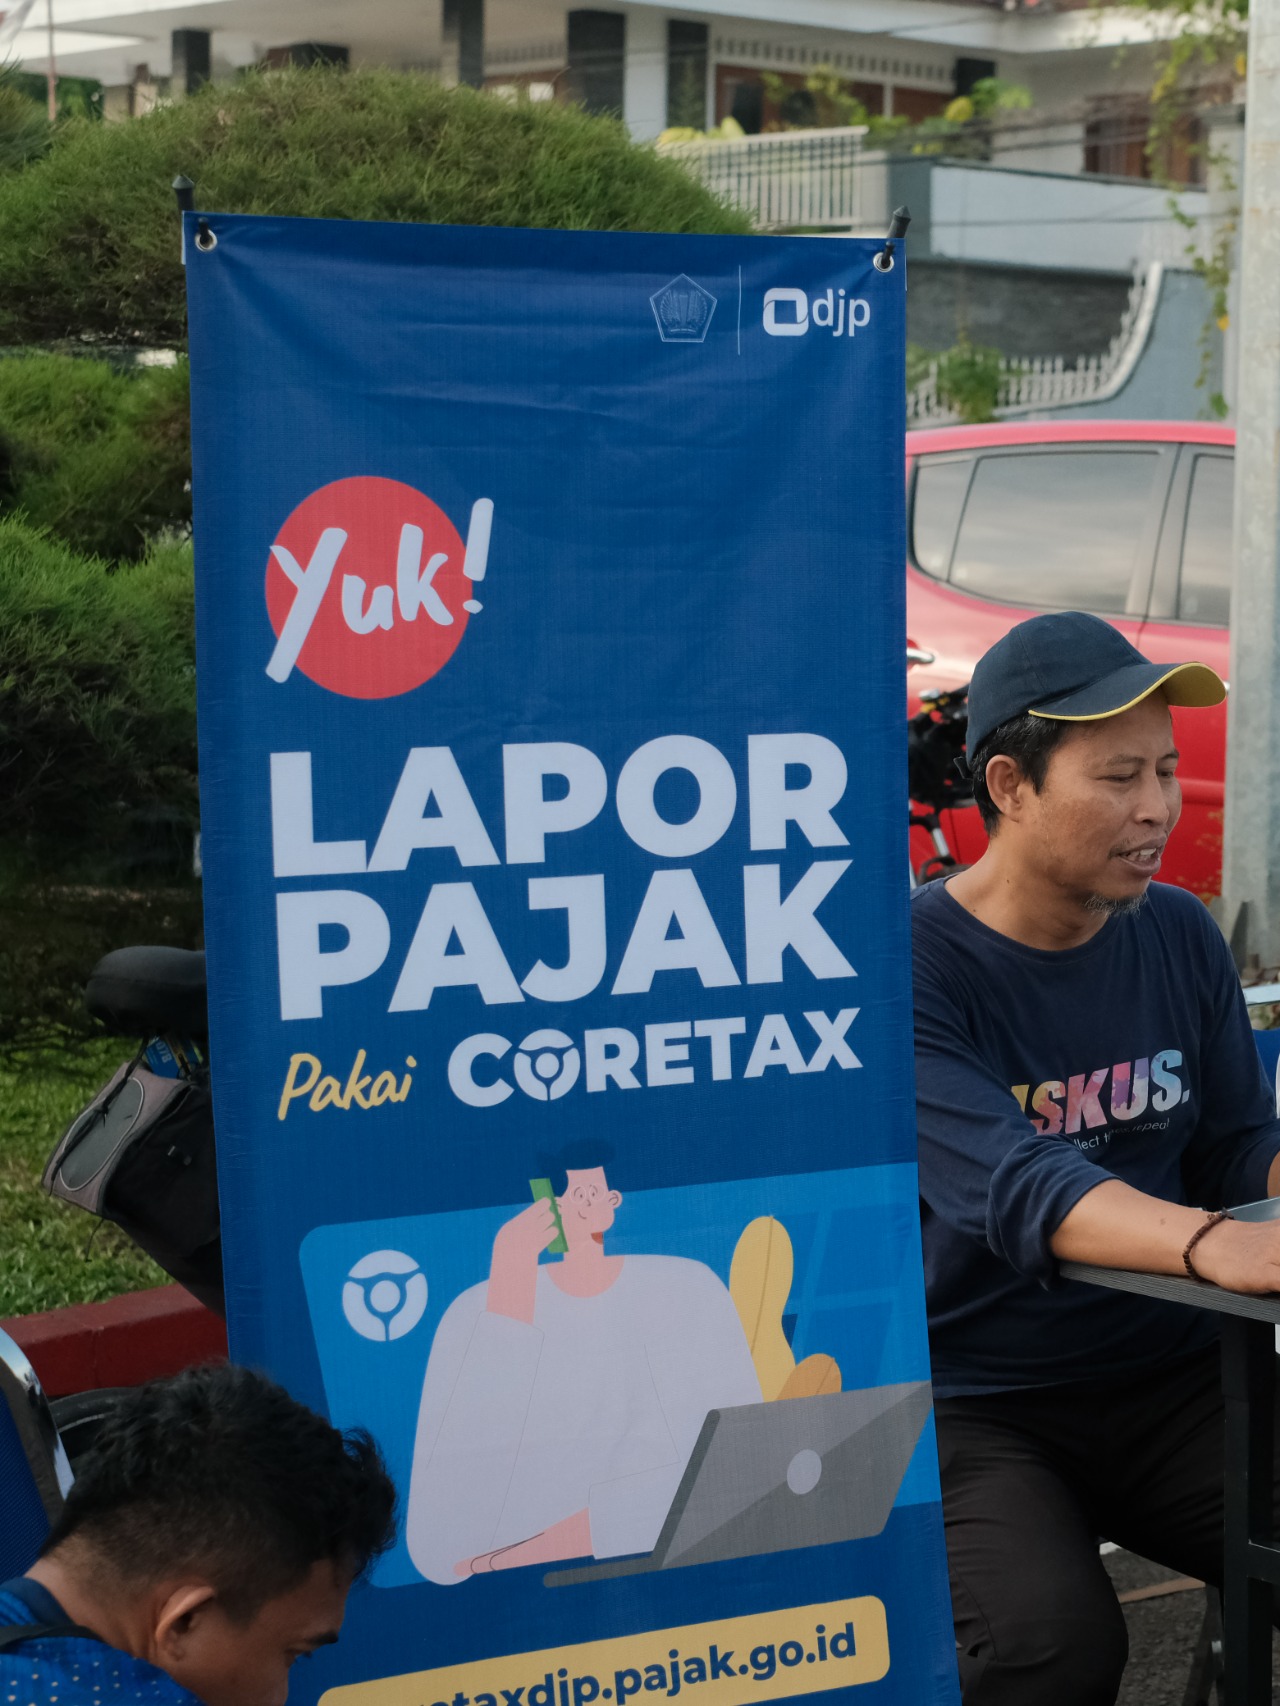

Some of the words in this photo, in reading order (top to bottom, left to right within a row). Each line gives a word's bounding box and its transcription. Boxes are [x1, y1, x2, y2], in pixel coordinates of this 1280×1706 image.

[812, 288, 871, 337] djp
[269, 732, 852, 878] LAPOR
[275, 859, 859, 1022] PAJAK
[277, 1049, 418, 1122] Pakai
[447, 1007, 864, 1109] CORETAX
[420, 1621, 857, 1706] taxdjp.pajak.go.id
